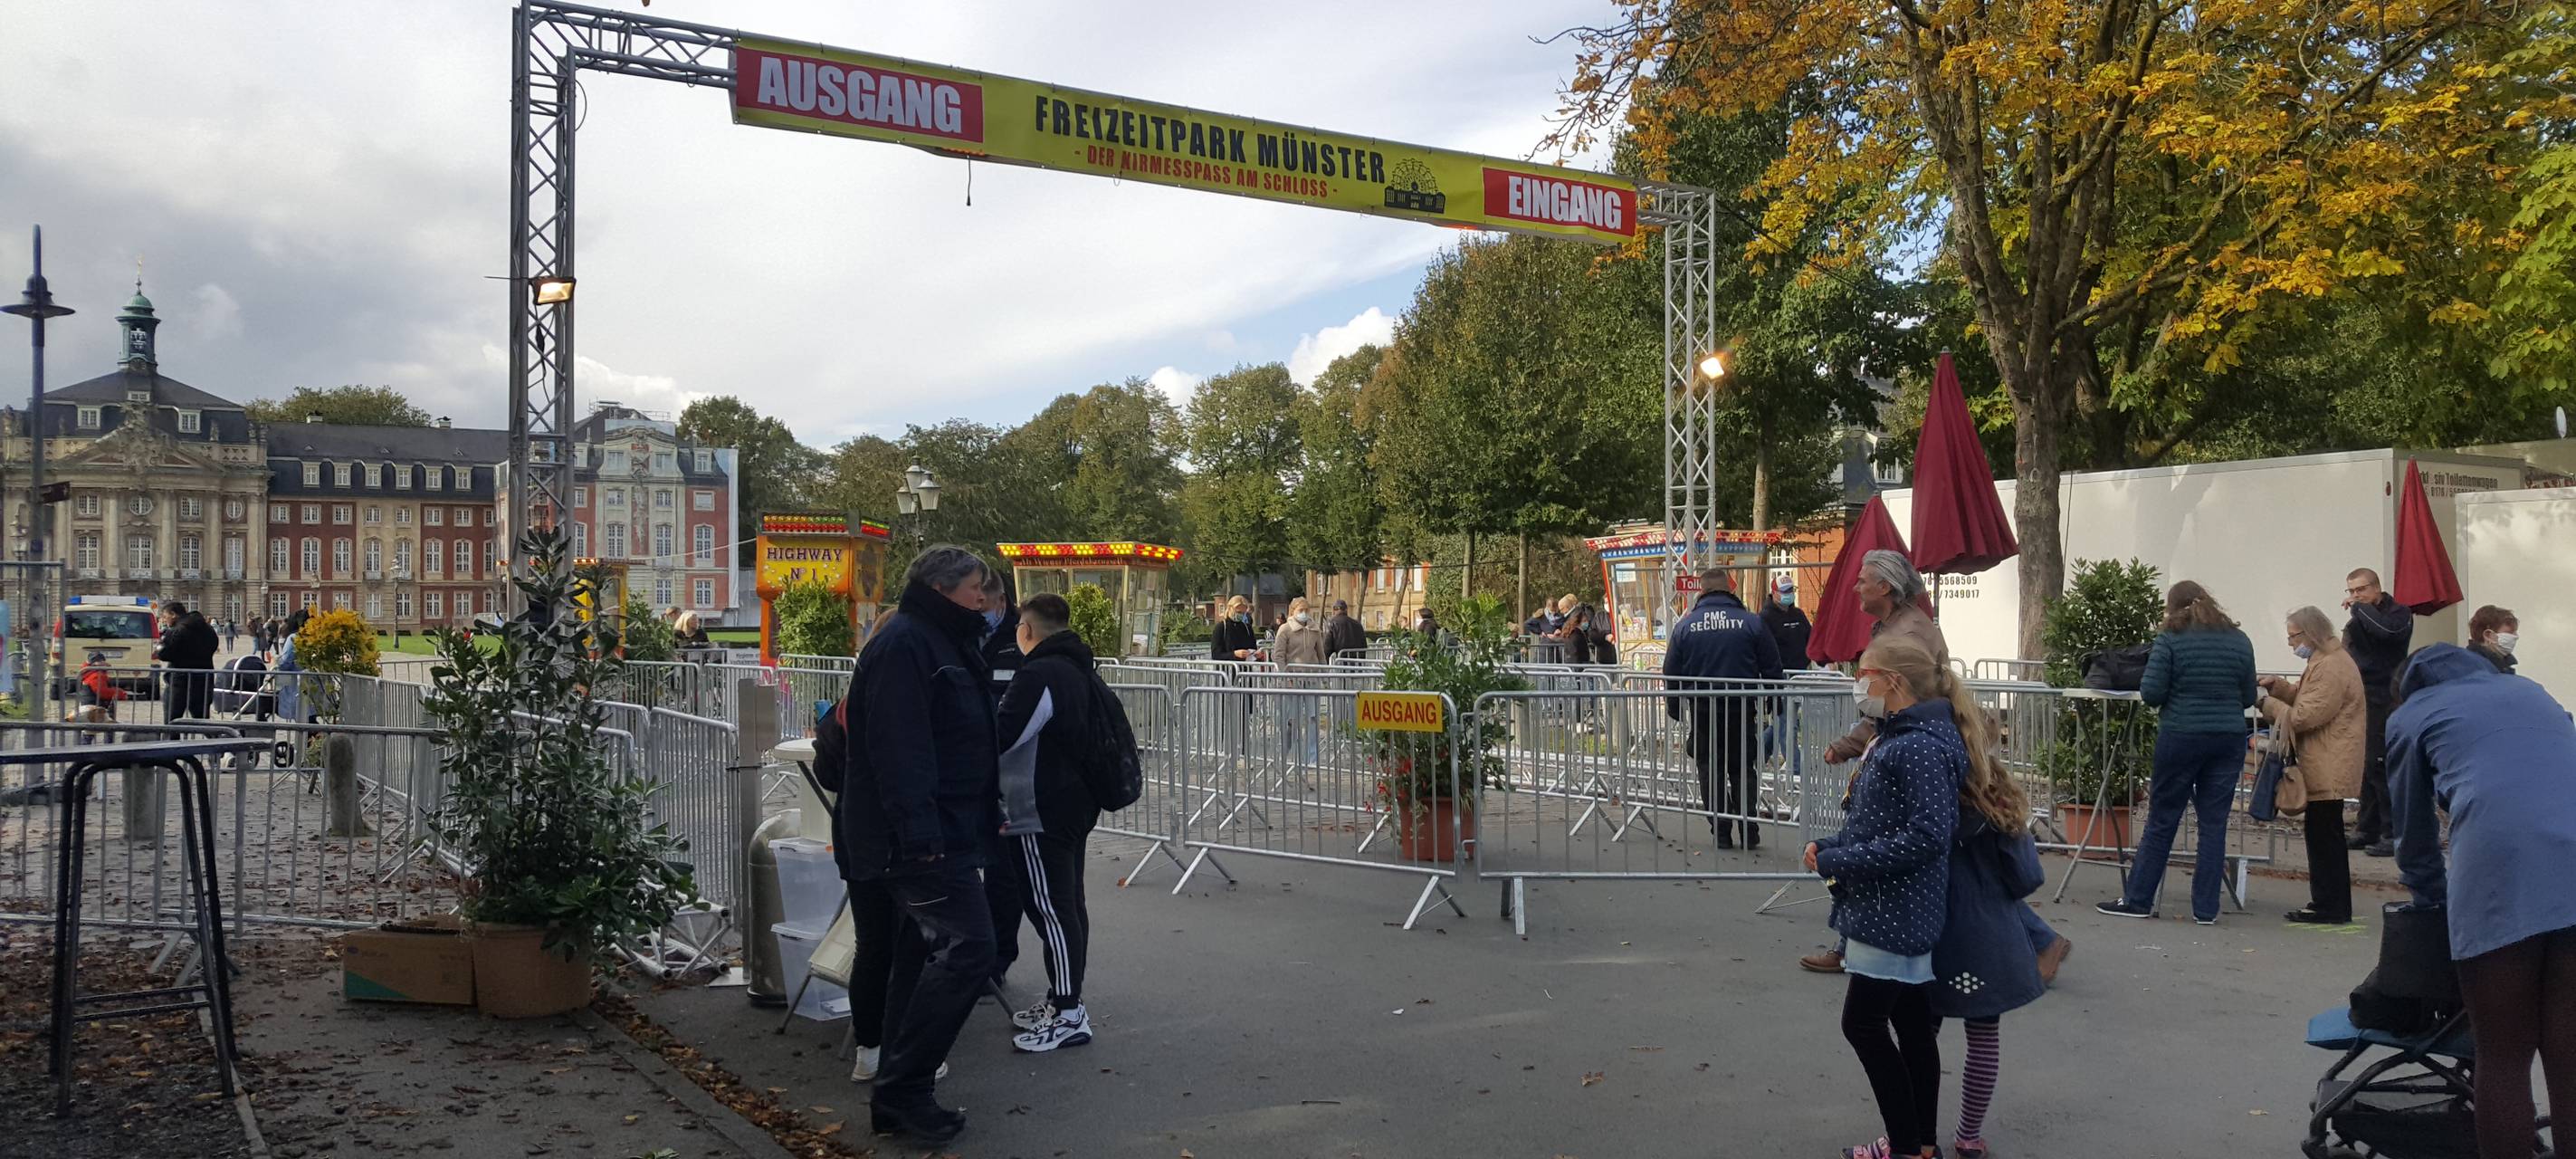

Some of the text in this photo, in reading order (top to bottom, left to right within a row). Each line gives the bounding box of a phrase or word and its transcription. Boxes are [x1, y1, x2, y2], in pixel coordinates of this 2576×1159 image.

[758, 55, 962, 133] AUSGANG
[1036, 95, 1385, 184] FREIZEITPARK MÜNSTER
[1088, 145, 1114, 168] DER
[1236, 168, 1258, 188] AM
[1264, 172, 1328, 197] SCHLOSS
[1508, 175, 1622, 230] EINGANG
[767, 547, 843, 562] HIGHWAY
[1690, 619, 1744, 632] SECURITY
[1703, 610, 1726, 622] PMC
[1361, 700, 1437, 725] AUSGANG
